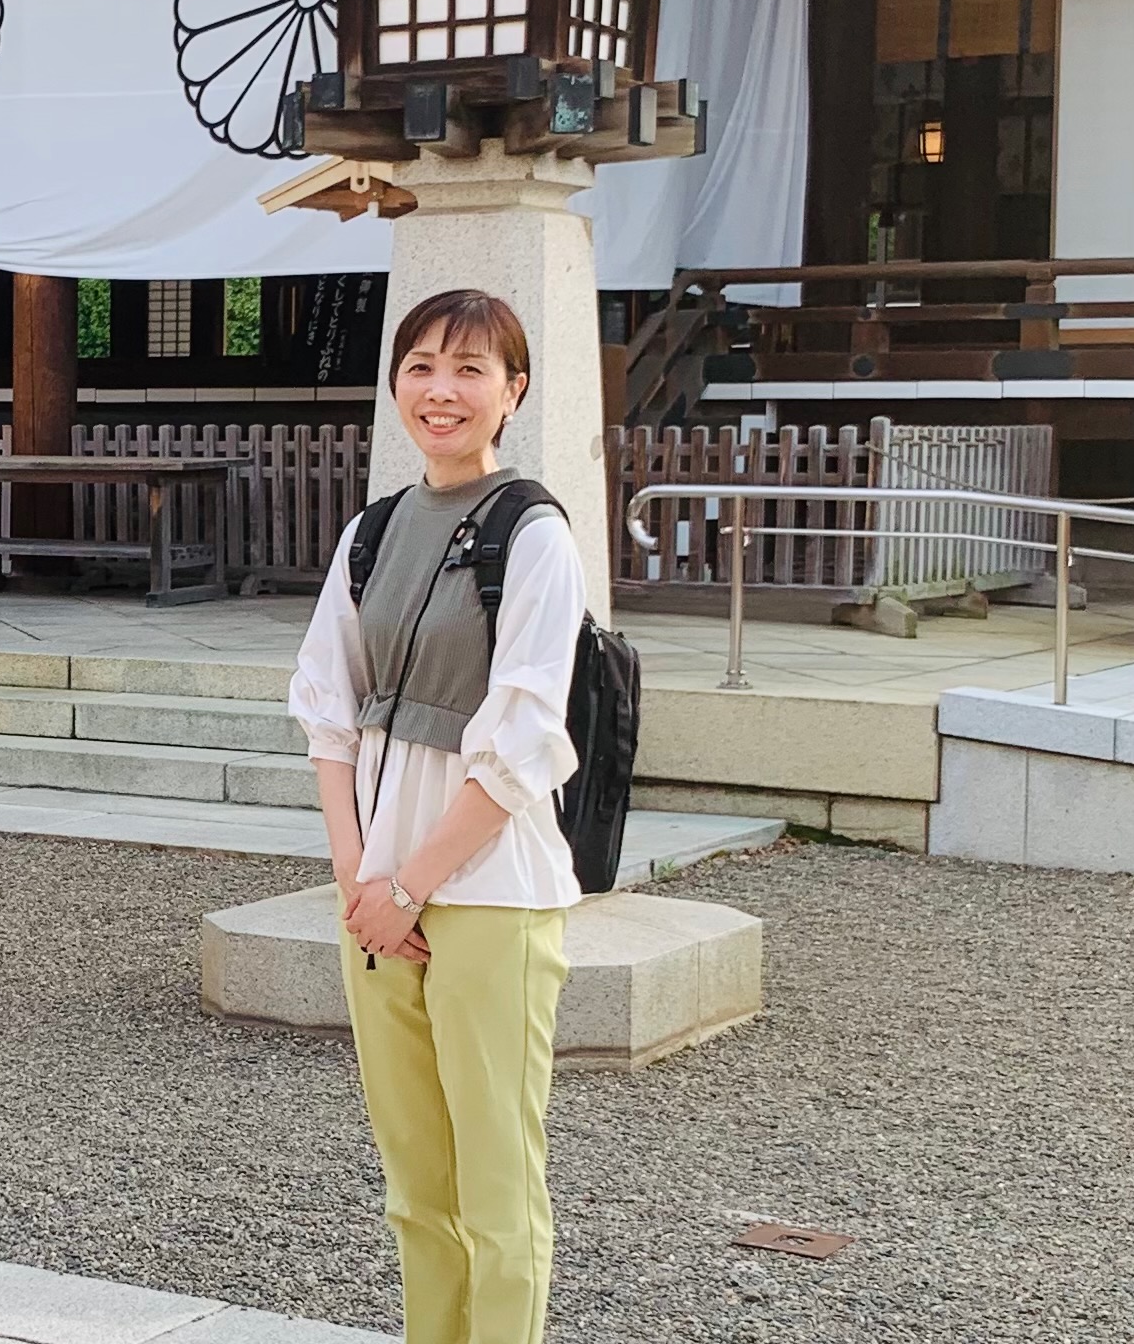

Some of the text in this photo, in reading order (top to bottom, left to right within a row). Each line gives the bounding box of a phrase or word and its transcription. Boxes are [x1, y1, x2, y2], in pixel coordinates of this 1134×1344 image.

[306, 274, 328, 346] となりにき
